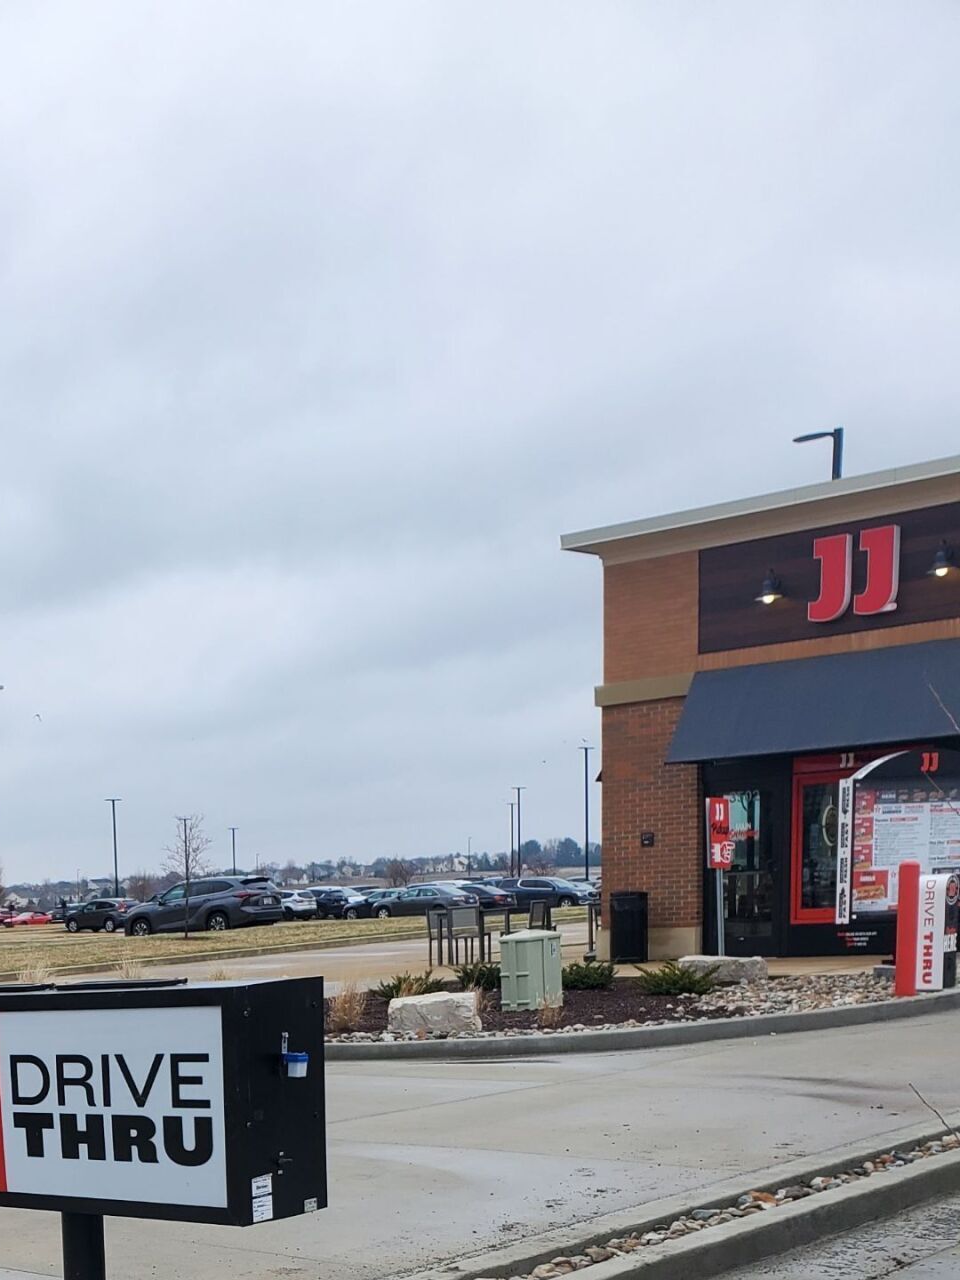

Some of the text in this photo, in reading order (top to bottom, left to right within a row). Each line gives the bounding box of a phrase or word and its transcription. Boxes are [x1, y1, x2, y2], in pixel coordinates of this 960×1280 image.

[808, 524, 900, 622] JJ
[840, 752, 855, 768] JJ
[921, 752, 939, 771] JJ
[922, 880, 937, 985] DRIVE THRU
[9, 1053, 211, 1109] DRIVE
[13, 1112, 214, 1167] THRU
